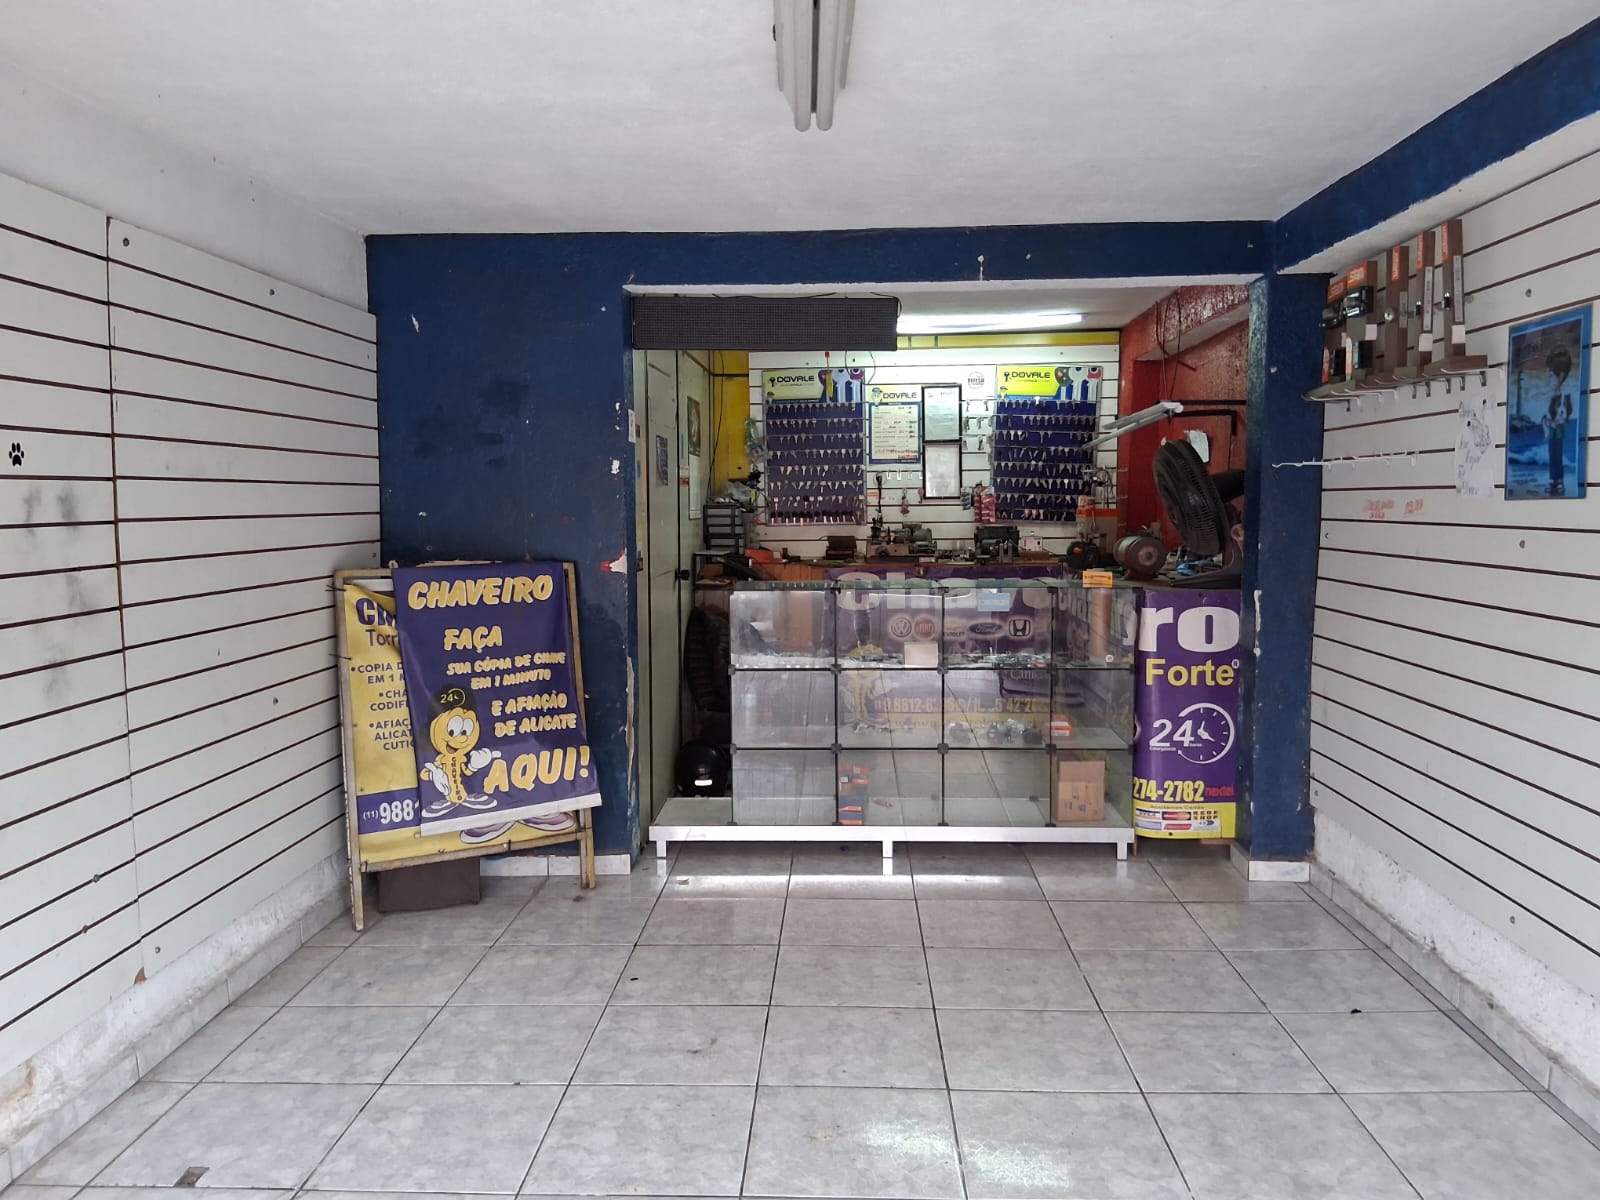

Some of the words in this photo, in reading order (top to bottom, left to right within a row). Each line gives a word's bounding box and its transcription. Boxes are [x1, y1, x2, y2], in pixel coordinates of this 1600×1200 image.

[776, 375, 815, 383] DOVALE
[1011, 371, 1051, 379] DOVALE
[408, 575, 554, 610] CHAVEIRO
[443, 625, 503, 653] FAÇA
[357, 663, 393, 673] COPIA
[446, 661, 471, 675] SUA
[473, 656, 512, 673] CÓPIA
[514, 654, 532, 667] DE
[533, 652, 566, 664] CHAVE
[367, 675, 385, 684] EM
[389, 674, 395, 682] 1
[470, 676, 492, 690] EM
[494, 675, 501, 687] 1
[503, 668, 552, 686] MINUTO
[491, 699, 503, 716] E
[505, 690, 567, 714] AFIAÇÃO
[494, 719, 517, 738] DE
[518, 713, 577, 733] ALICATE
[1149, 719, 1195, 747] 24
[483, 745, 591, 794] AQUI!
[363, 810, 379, 821] (11)
